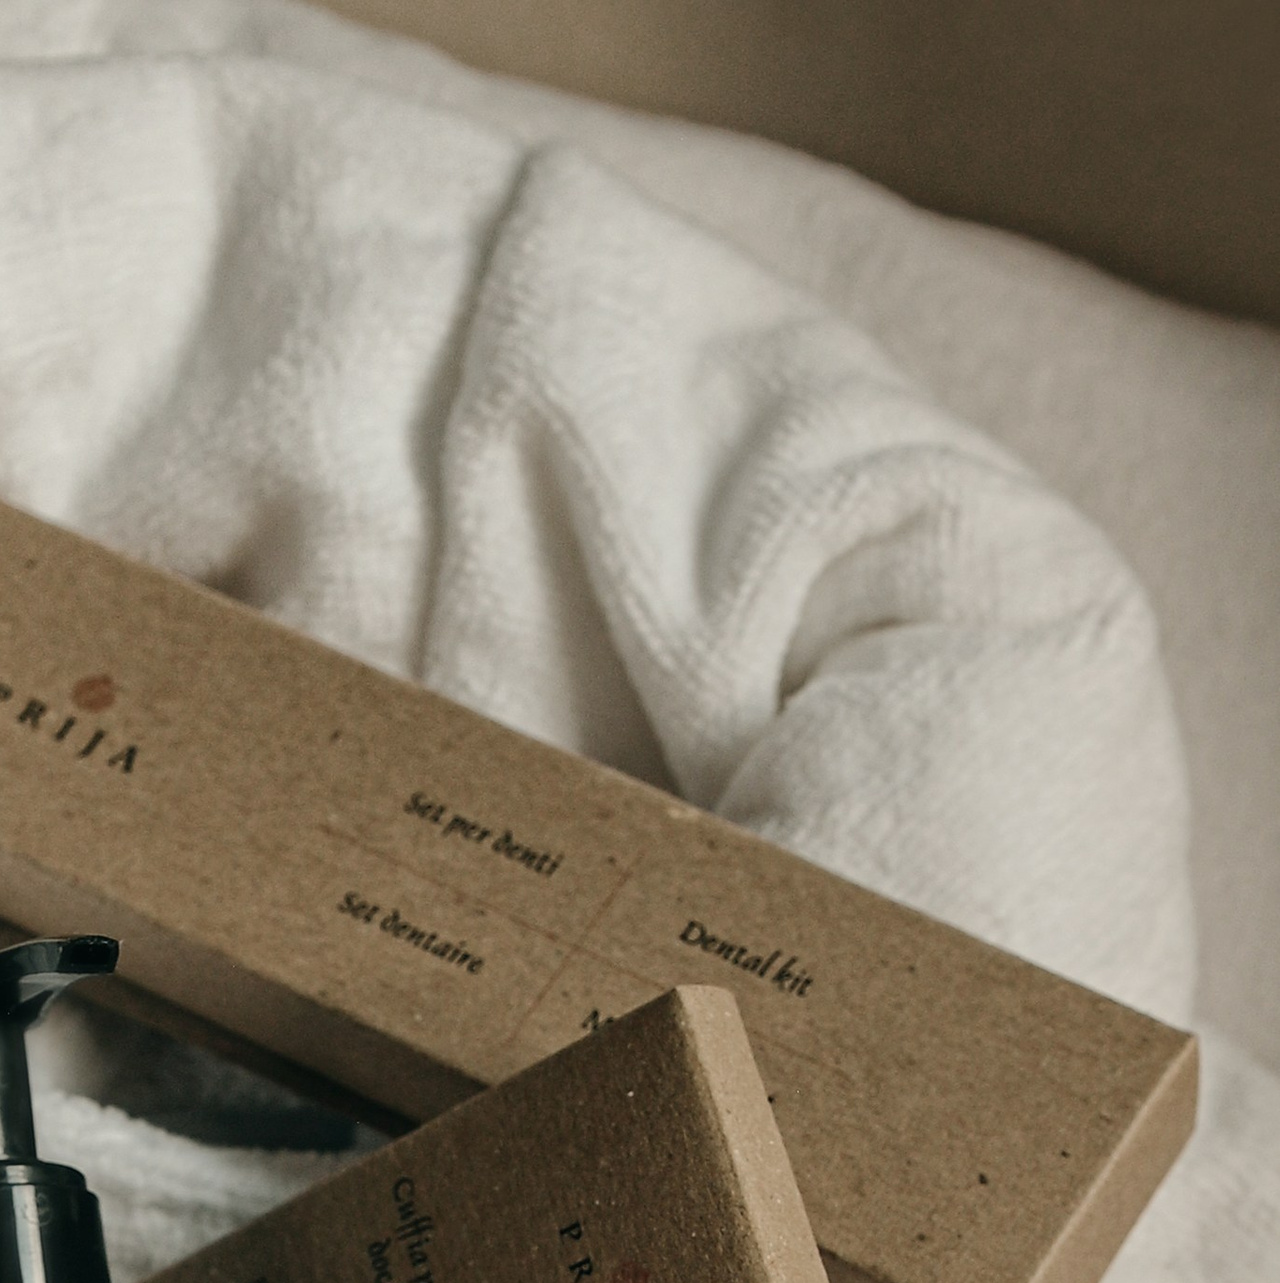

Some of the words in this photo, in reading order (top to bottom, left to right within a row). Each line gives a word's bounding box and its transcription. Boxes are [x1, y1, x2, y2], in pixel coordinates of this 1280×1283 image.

[404, 791, 447, 825] Set
[441, 814, 491, 844] per
[491, 829, 565, 878] denti
[337, 891, 381, 924] Set
[380, 908, 485, 975] dentaire
[679, 920, 782, 978] Dental
[773, 956, 814, 998] kit
[392, 1176, 434, 1267] Cuffia
